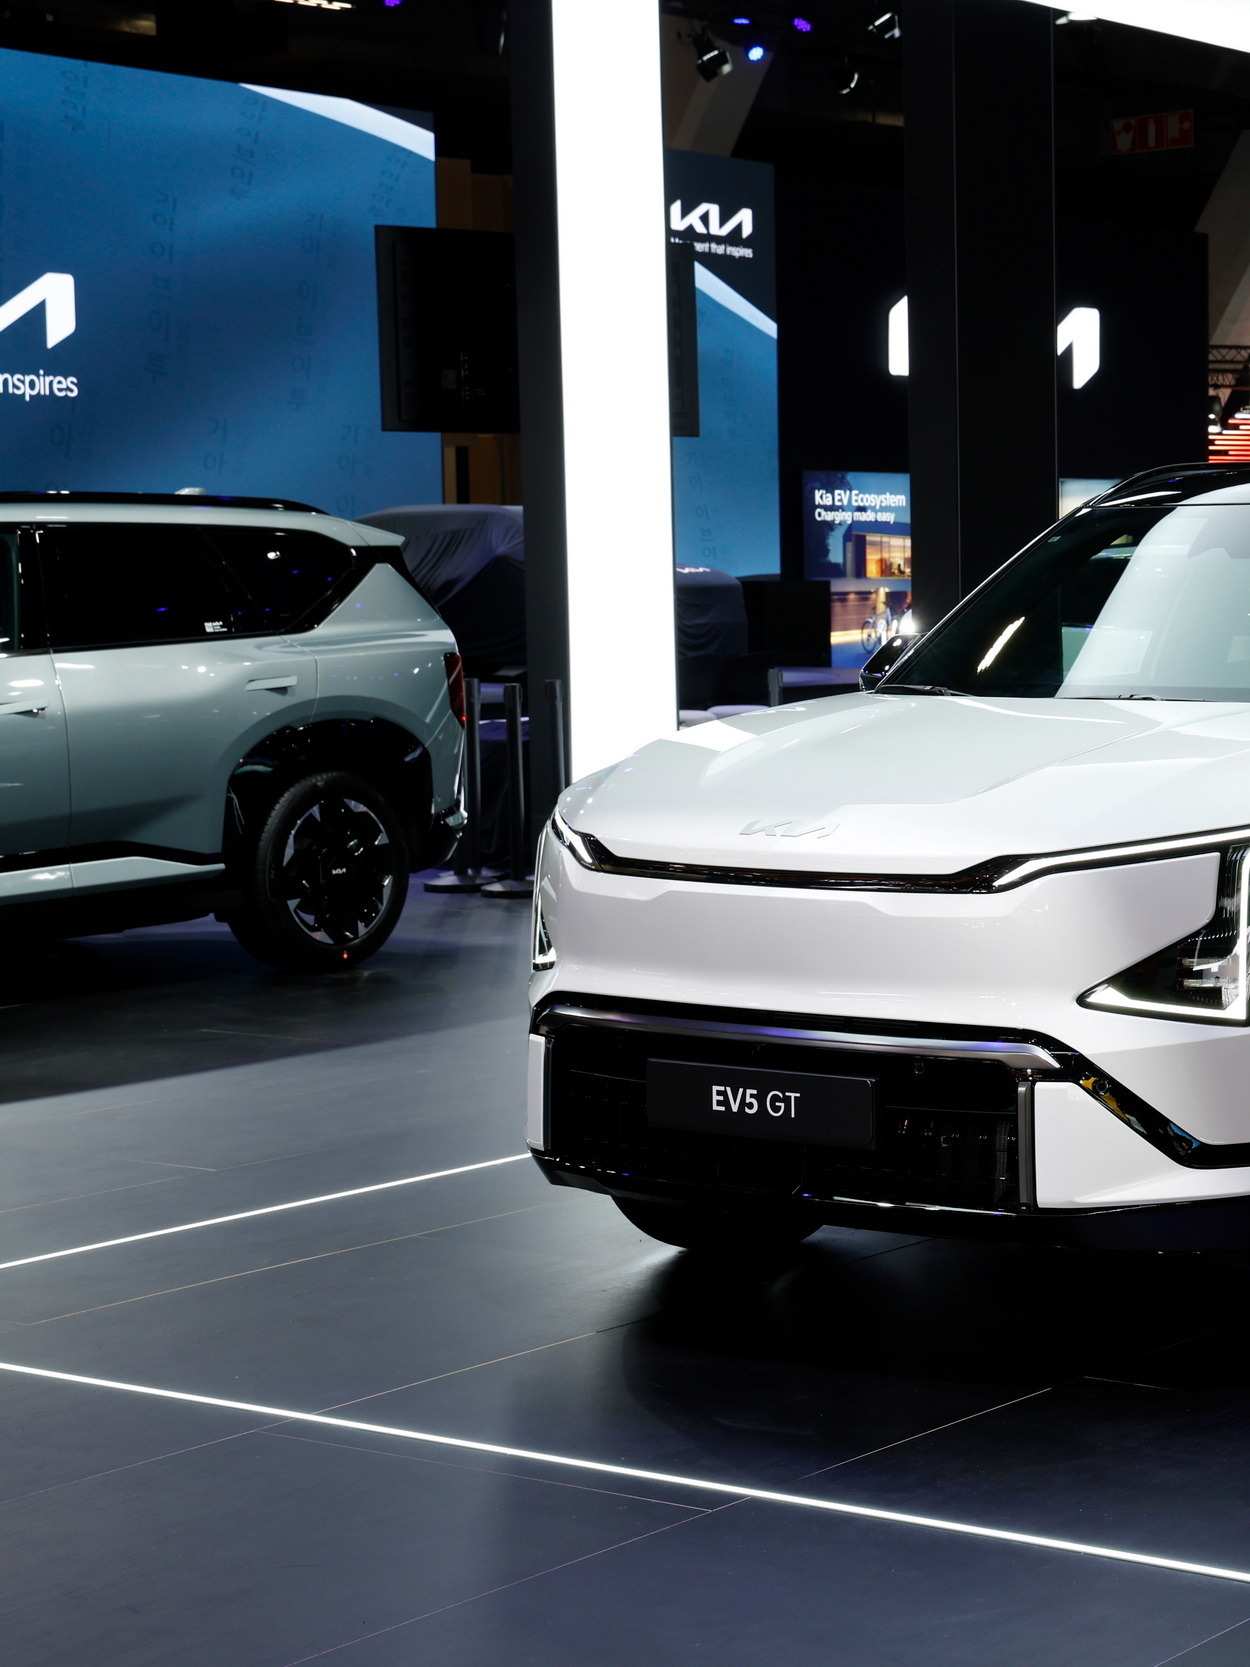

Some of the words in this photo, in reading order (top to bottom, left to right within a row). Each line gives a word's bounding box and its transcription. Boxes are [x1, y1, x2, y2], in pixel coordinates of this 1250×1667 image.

[669, 198, 753, 240] KIA
[710, 241, 726, 255] that
[726, 244, 754, 259] inspires
[0, 369, 79, 402] nspires
[814, 488, 833, 507] Kia
[833, 489, 851, 507] EV
[851, 489, 907, 510] Ecosystem
[814, 508, 852, 525] Charging
[853, 509, 876, 523] made
[877, 512, 896, 525] easy
[738, 819, 841, 840] KIA
[711, 1084, 760, 1115] EV5
[766, 1090, 801, 1118] GT
